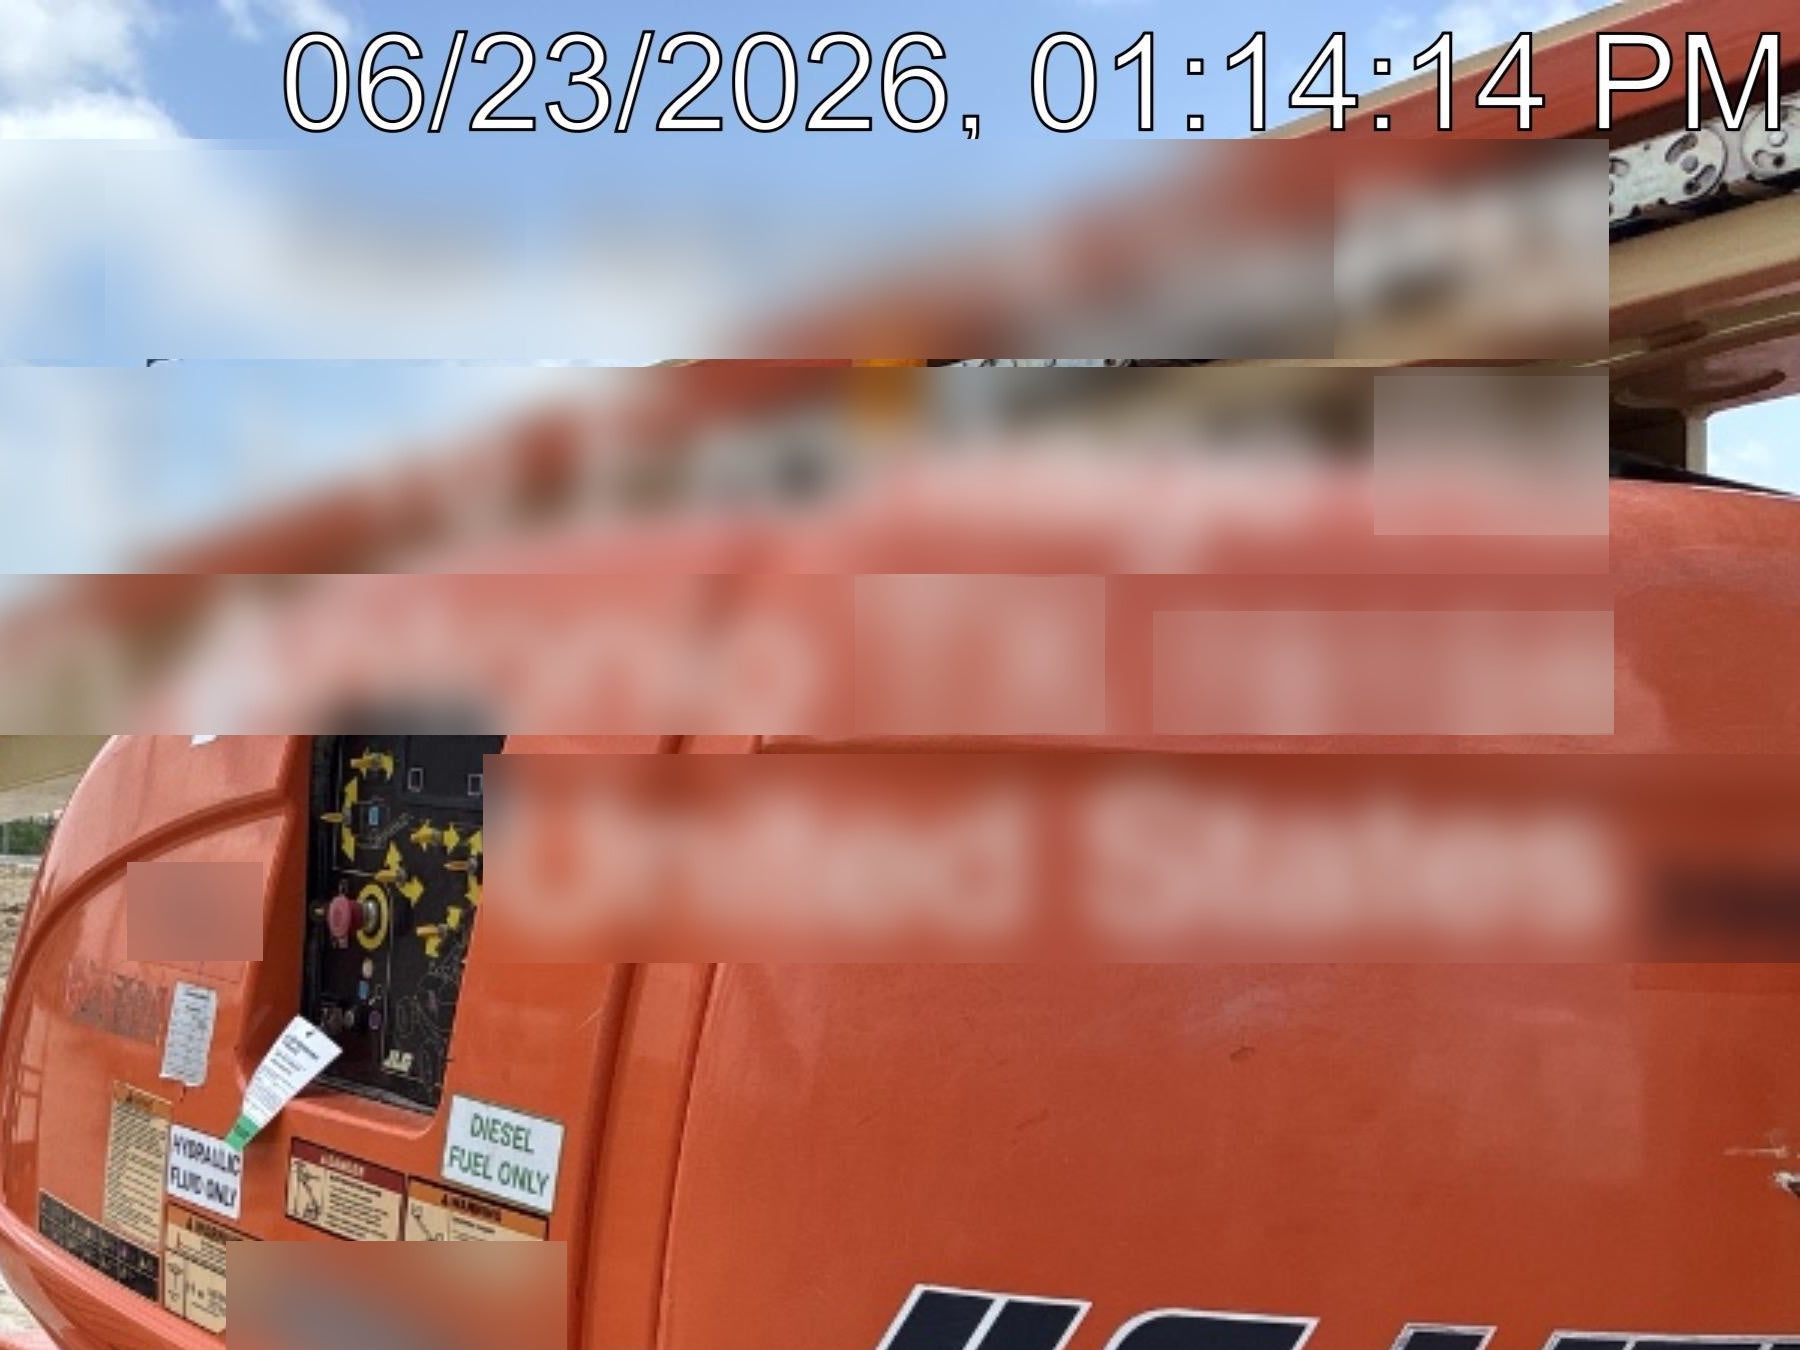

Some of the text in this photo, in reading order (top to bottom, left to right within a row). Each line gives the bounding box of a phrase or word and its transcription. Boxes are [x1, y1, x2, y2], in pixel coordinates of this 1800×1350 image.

[470, 1112, 535, 1154] DIESEL
[173, 1134, 241, 1177] HYDRAULIC
[449, 1145, 550, 1197] FUEL ONLY
[170, 1166, 238, 1208] FLUID ONLY
